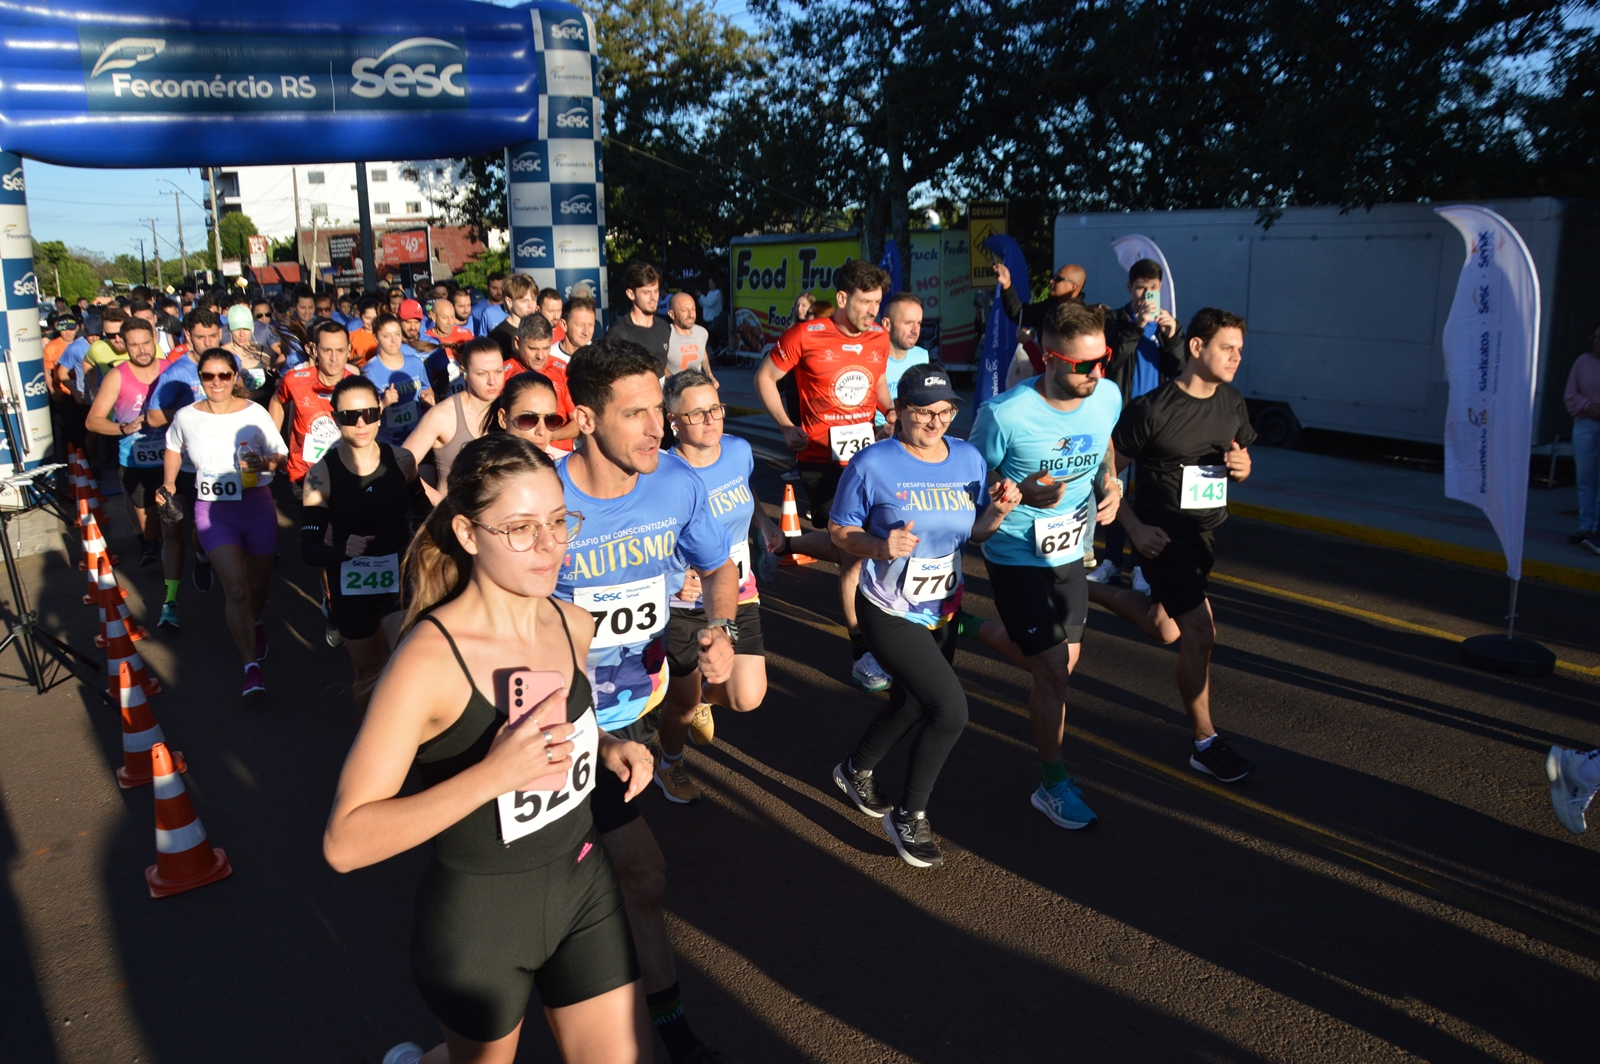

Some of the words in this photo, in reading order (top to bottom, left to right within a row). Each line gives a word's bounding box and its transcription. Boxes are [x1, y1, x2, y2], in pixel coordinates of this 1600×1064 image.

[551, 24, 584, 40] Sesc
[112, 73, 273, 99] Fecomércio
[281, 76, 316, 98] RS
[351, 58, 466, 98] Sesc
[556, 113, 589, 128] Sesc
[512, 158, 542, 172] Sesc
[2, 173, 25, 191] Ses
[560, 200, 592, 214] Sesc
[972, 206, 1004, 217] DEVAGAR
[405, 237, 418, 253] 49
[517, 244, 546, 258] Sesc
[911, 244, 938, 260] ruck
[736, 248, 787, 291] Food
[974, 266, 997, 279] ELEVA
[14, 280, 36, 296] Ses
[565, 286, 597, 298] Sc
[1478, 285, 1490, 314] Sesc
[768, 304, 793, 326] Food
[992, 308, 1000, 348] Sindicatos
[682, 345, 697, 353] FILA
[992, 359, 999, 371] RS
[1478, 331, 1490, 392] Sindicatos
[991, 371, 999, 397] mércio
[394, 411, 411, 423] 40
[314, 446, 327, 459] 7
[836, 437, 870, 455] 736
[1040, 458, 1063, 471] BIG
[1067, 453, 1099, 468] FORT
[1478, 428, 1487, 494] Fecomércio
[200, 481, 237, 496] 660
[1189, 482, 1224, 501] 143
[708, 484, 751, 518] TISMO
[907, 487, 975, 511] AUTISMO
[600, 534, 611, 543] EM
[613, 517, 677, 539] CONSCIENTIZAÇÃO
[1048, 521, 1064, 530] Sesc
[1041, 526, 1083, 555] 627
[570, 530, 675, 581] AUTISMO
[922, 563, 941, 571] Sesc
[346, 570, 394, 588] 248
[912, 571, 957, 595] 770
[593, 592, 622, 602] Sesc
[590, 602, 657, 638] 703
